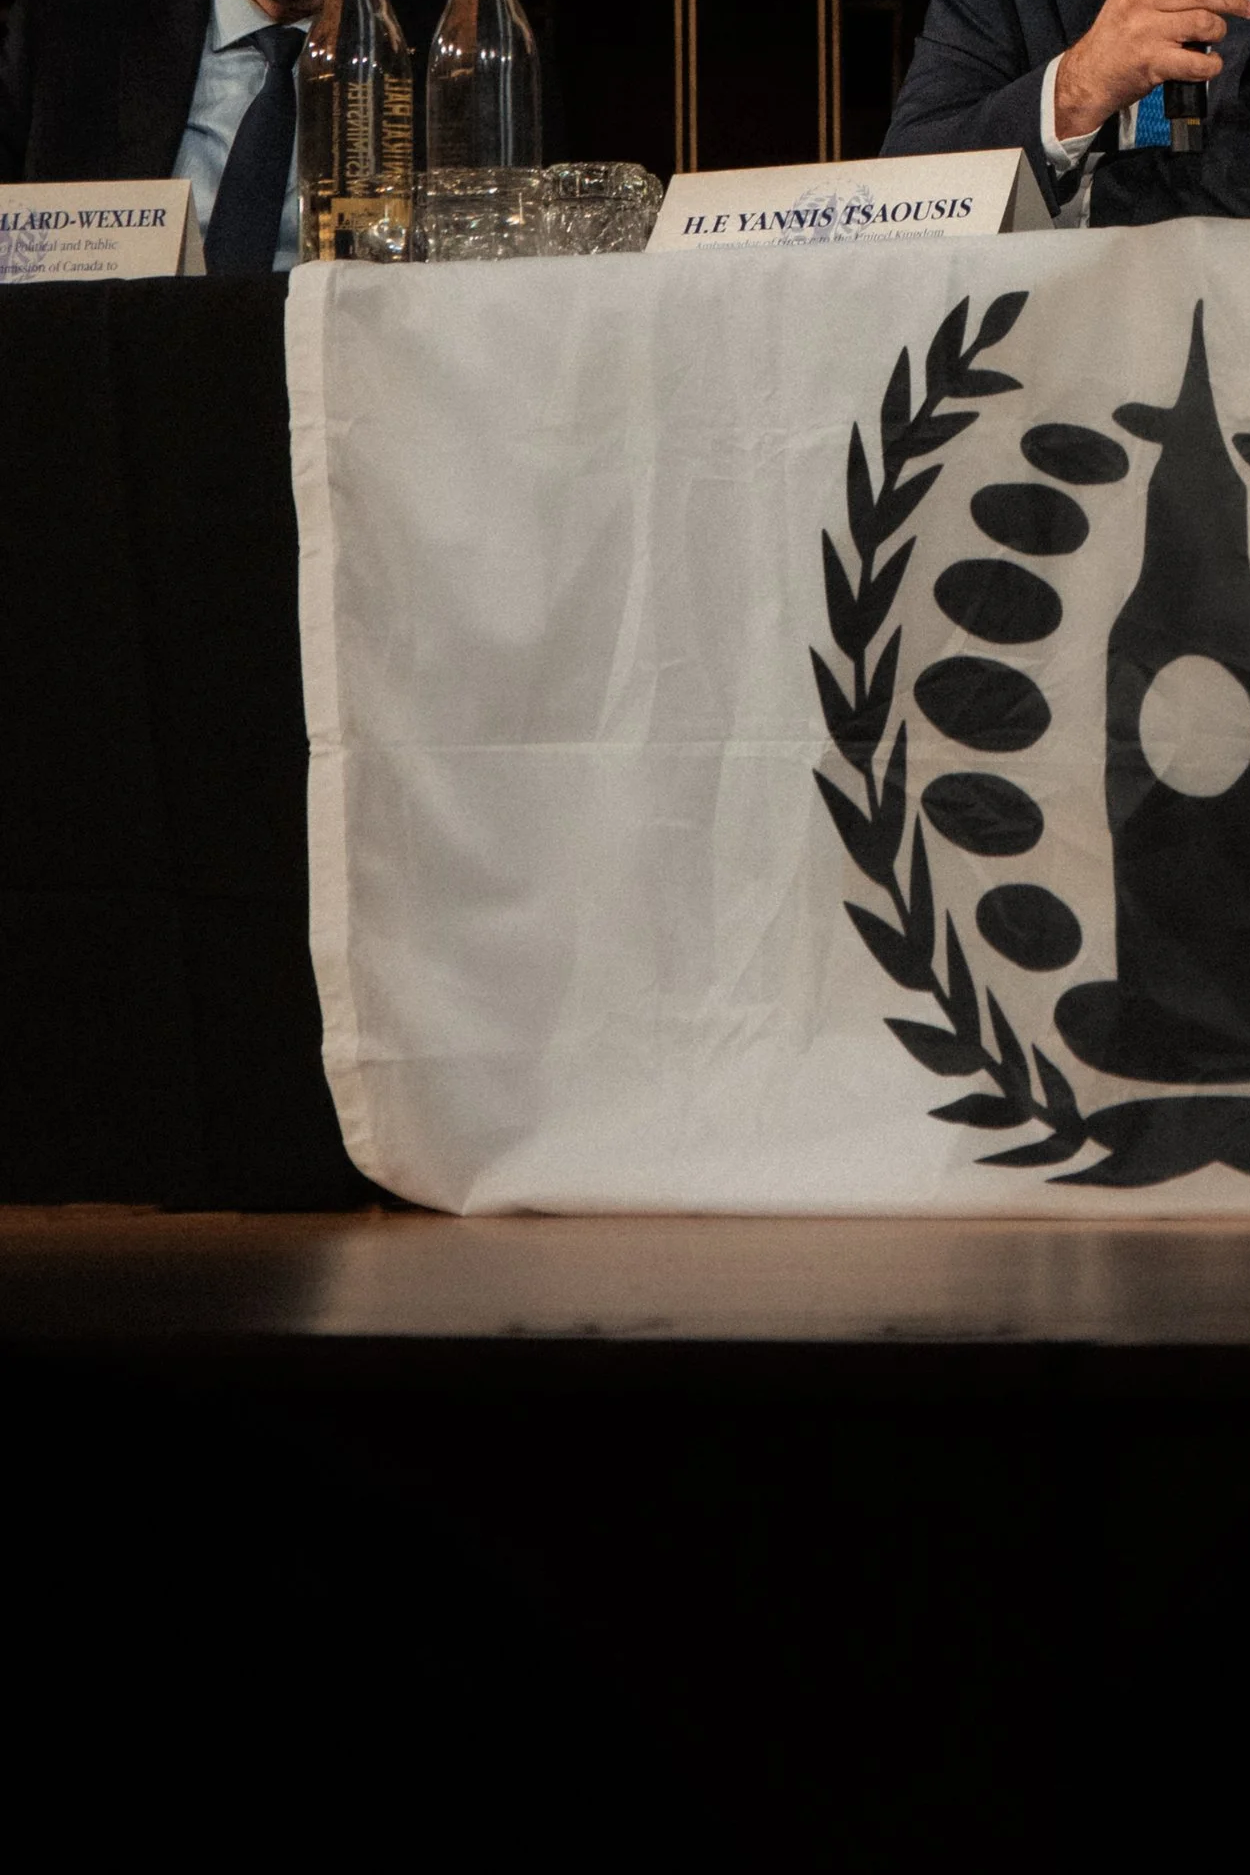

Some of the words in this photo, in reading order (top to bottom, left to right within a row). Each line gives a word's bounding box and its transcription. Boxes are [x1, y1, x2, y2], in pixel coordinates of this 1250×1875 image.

[682, 214, 730, 235] H.E
[738, 206, 834, 232] YANNIS
[843, 196, 973, 225] TSAOUSIS
[15, 240, 57, 252] Political
[60, 239, 82, 251] and
[84, 237, 119, 250] Public
[48, 260, 60, 272] of
[63, 260, 103, 272] Canada
[107, 261, 119, 271] to
